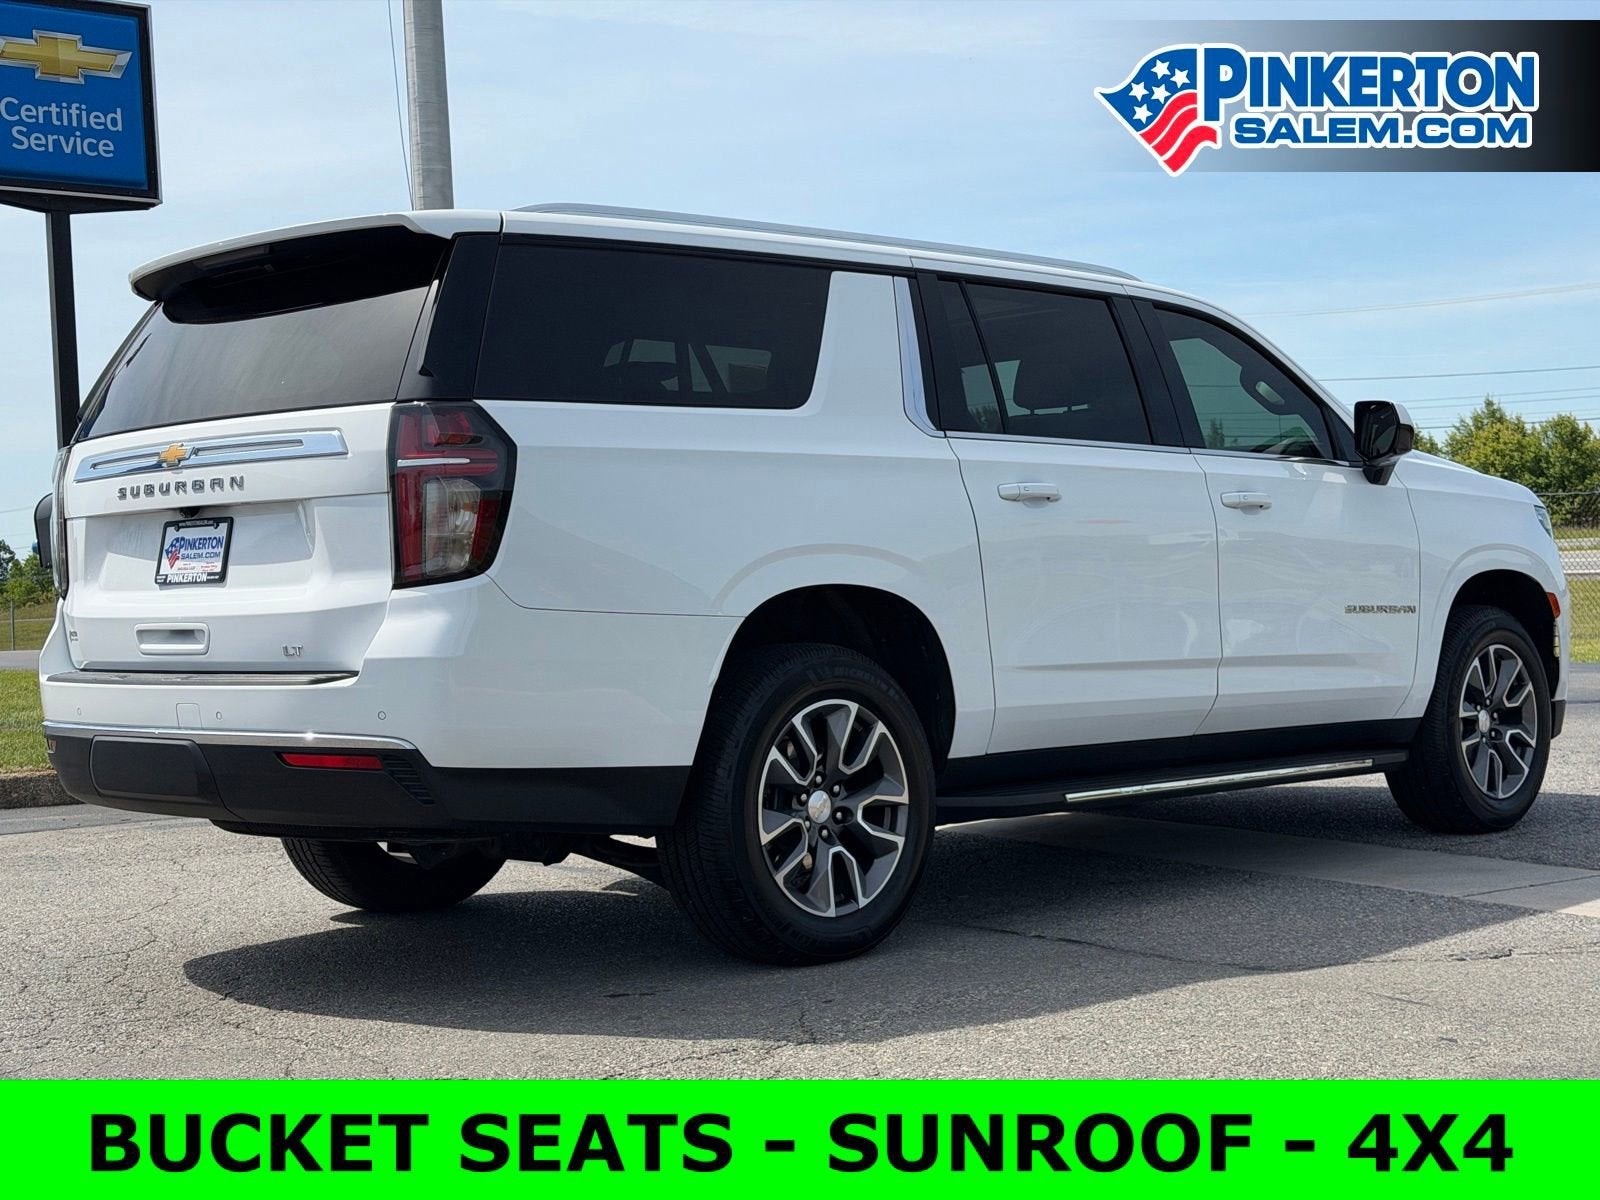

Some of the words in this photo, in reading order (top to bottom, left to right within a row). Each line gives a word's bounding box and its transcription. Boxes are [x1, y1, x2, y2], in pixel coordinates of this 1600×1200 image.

[0, 96, 123, 132] Certified
[11, 126, 115, 158] Service
[117, 475, 245, 501] SUBURBAN
[178, 535, 225, 554] PINKERTON
[180, 551, 221, 560] SALEM.COM
[166, 572, 208, 583] PINKERTON
[1344, 604, 1417, 614] SUBURBAN
[282, 643, 304, 657] LT
